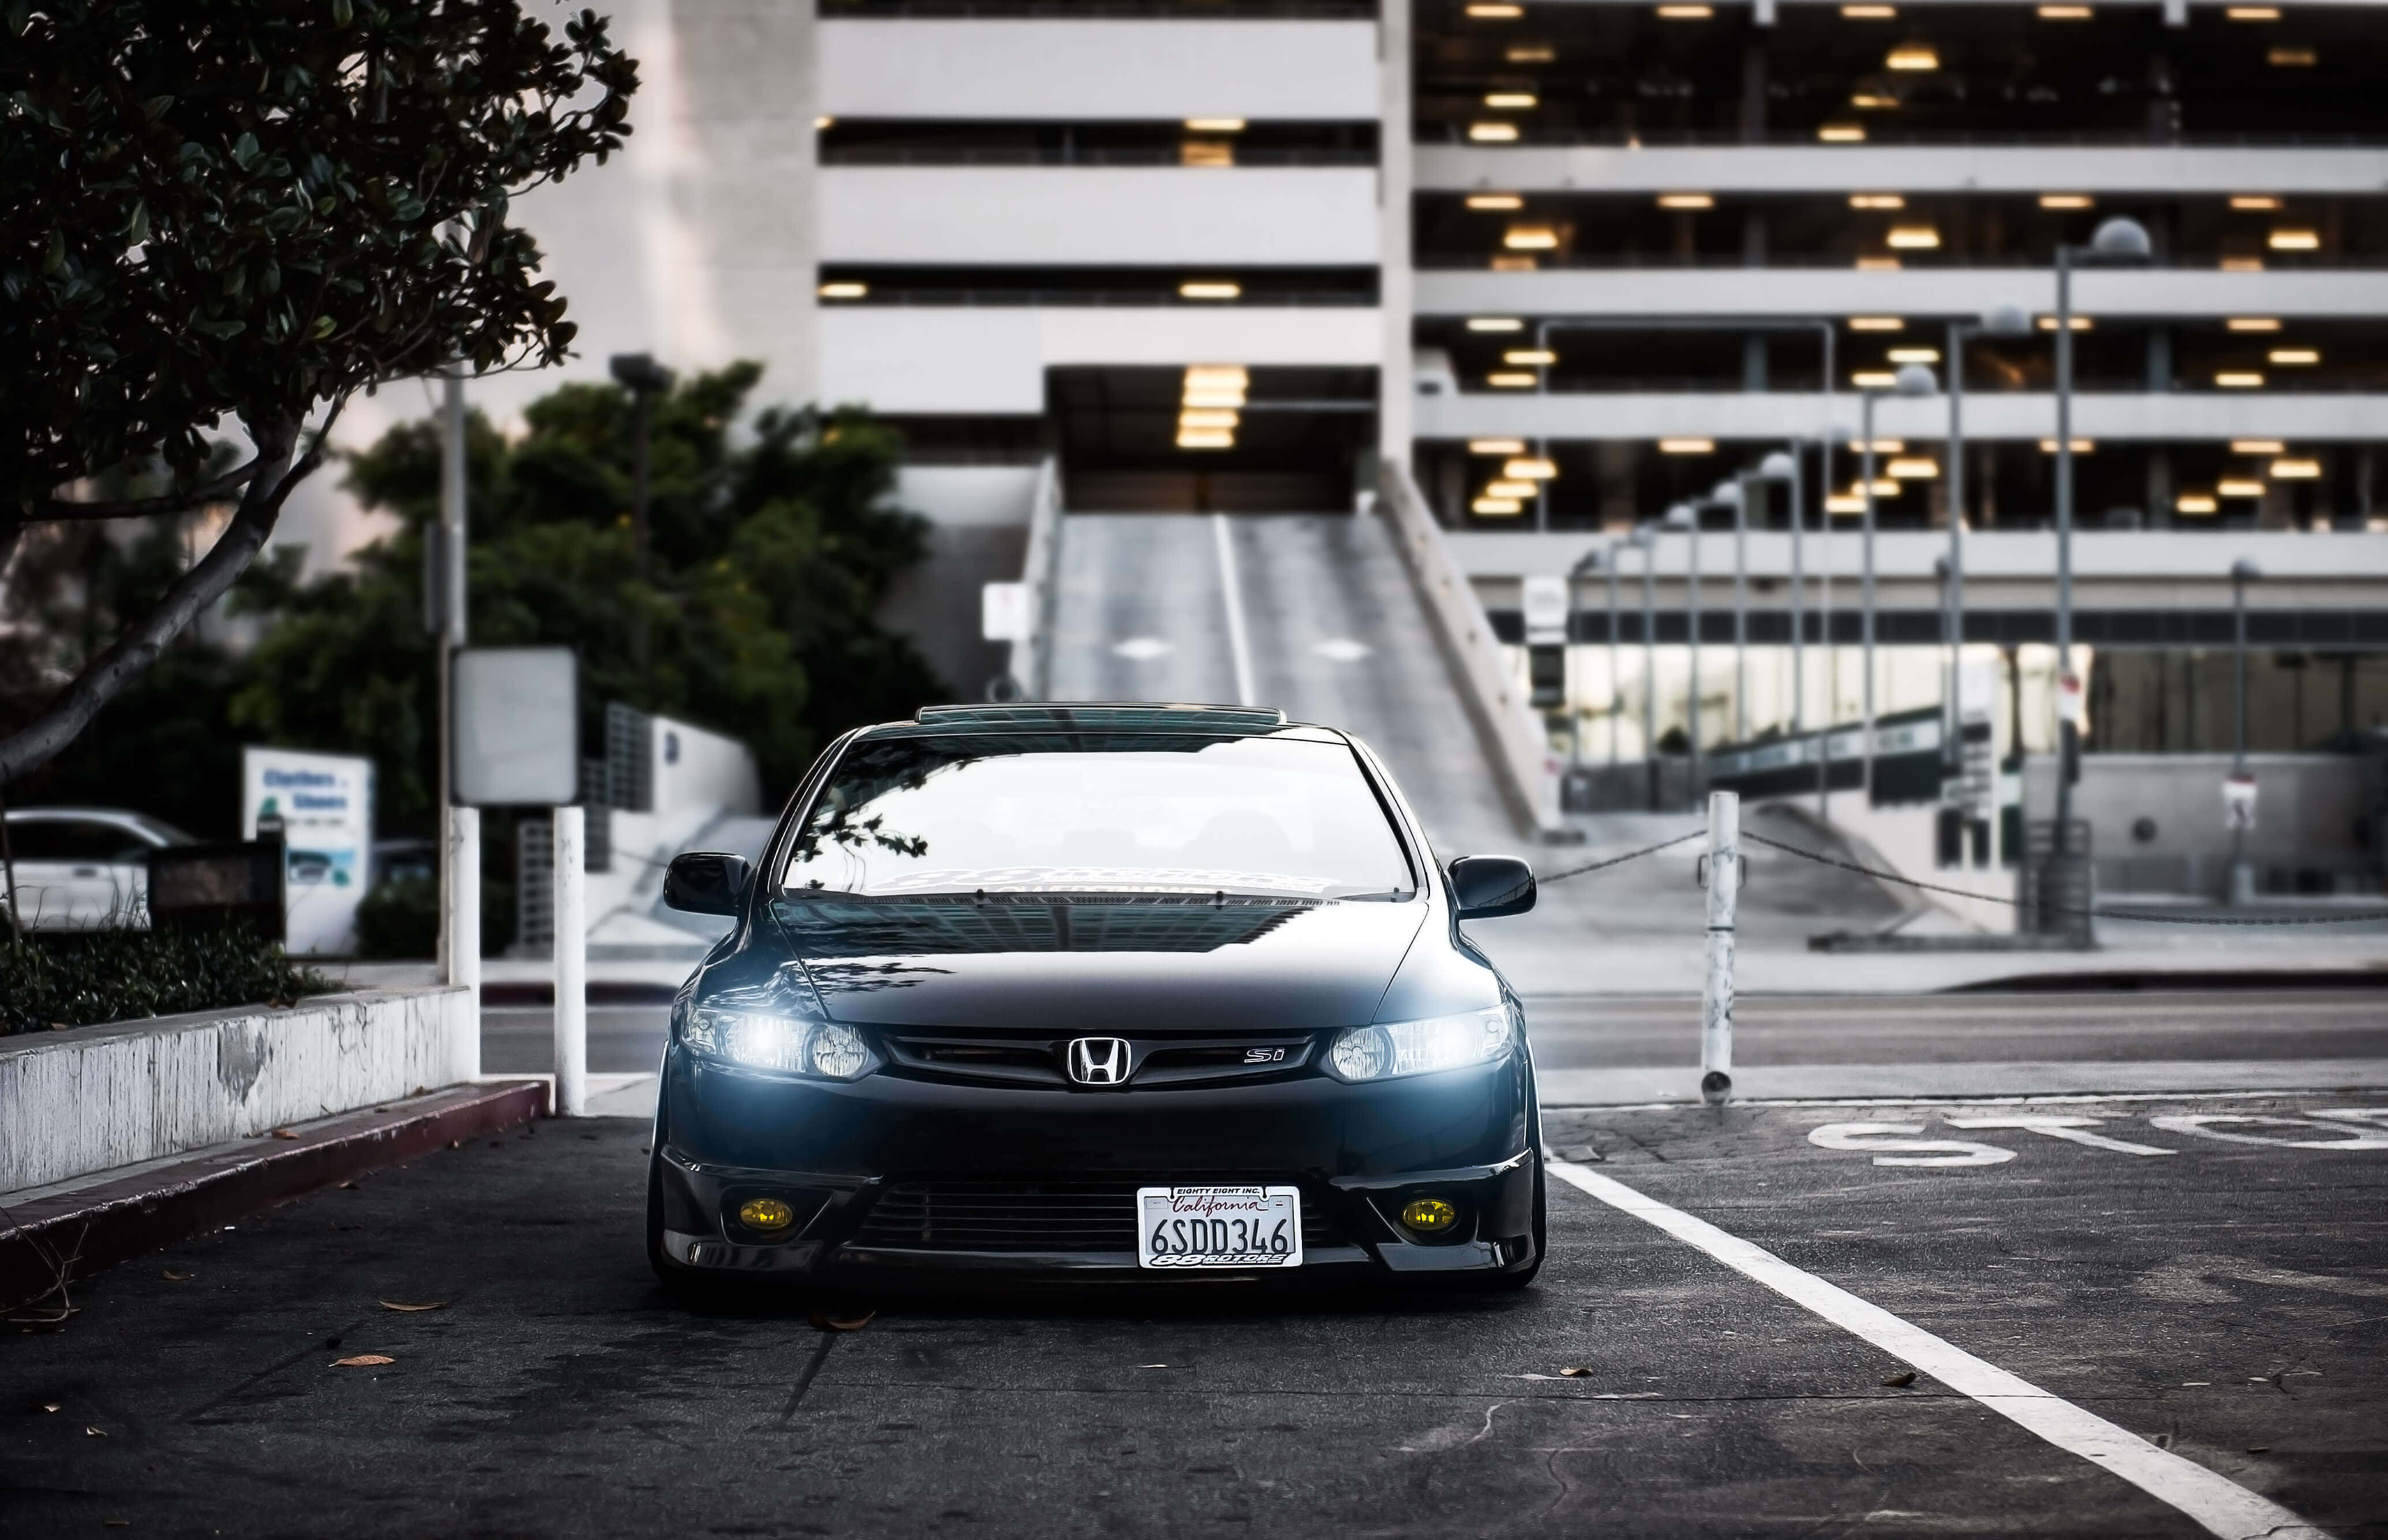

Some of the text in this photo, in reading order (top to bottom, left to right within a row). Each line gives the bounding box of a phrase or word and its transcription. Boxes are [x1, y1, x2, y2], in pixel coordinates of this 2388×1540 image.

[1807, 1107, 2388, 1167] STO
[1172, 1196, 1269, 1217] California
[1151, 1218, 1287, 1254] 6SDD346
